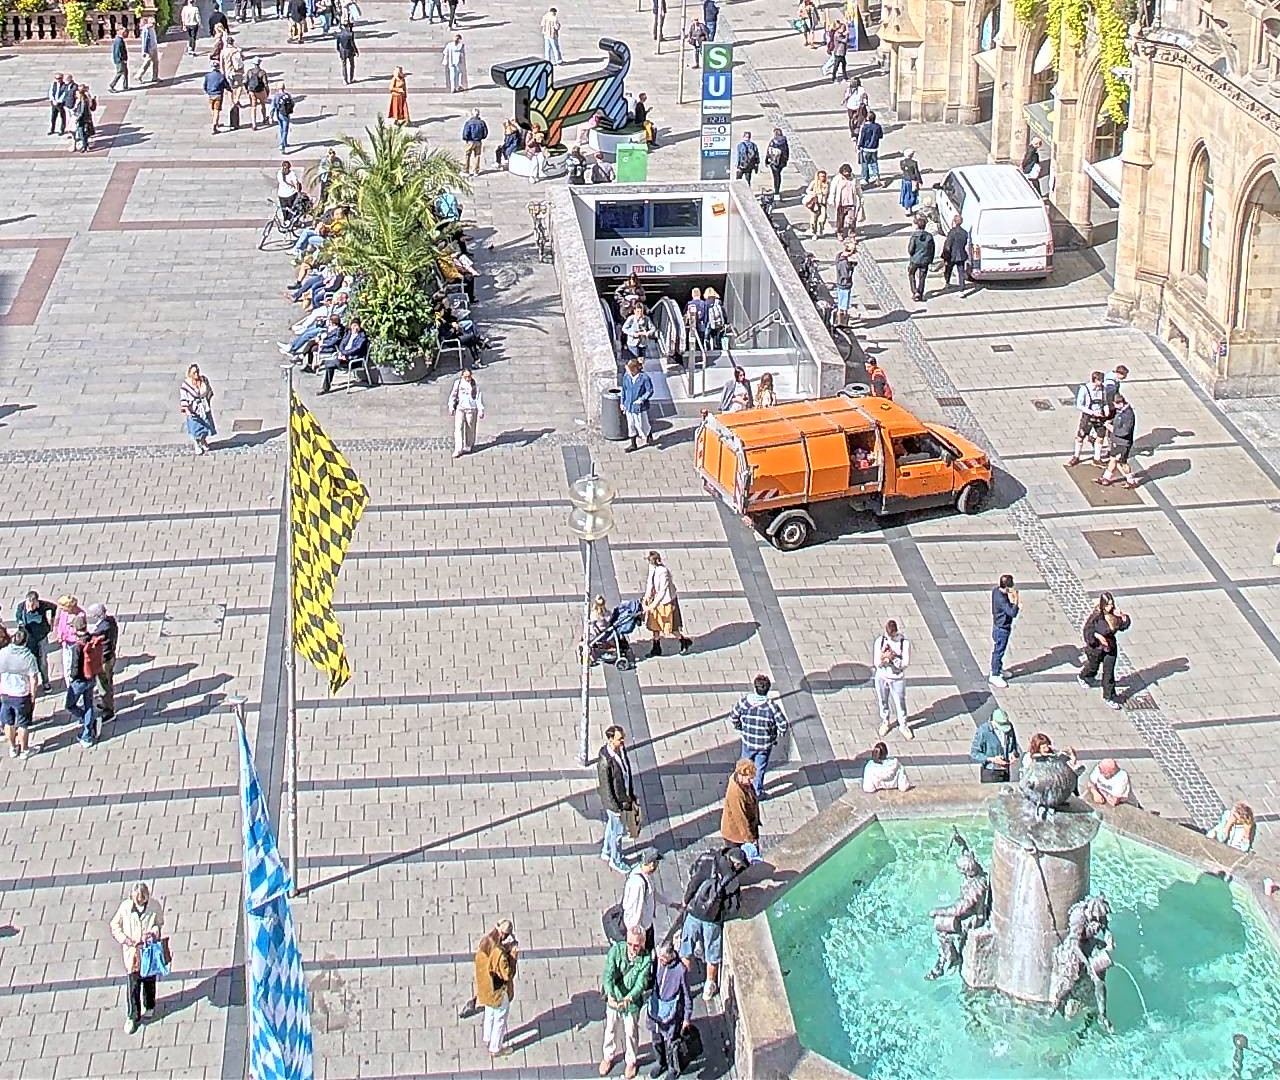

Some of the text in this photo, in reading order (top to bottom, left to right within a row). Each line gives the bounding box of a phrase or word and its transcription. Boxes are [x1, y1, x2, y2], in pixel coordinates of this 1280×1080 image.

[708, 46, 728, 69] S
[708, 75, 726, 97] U
[610, 244, 686, 258] Marienplatz
